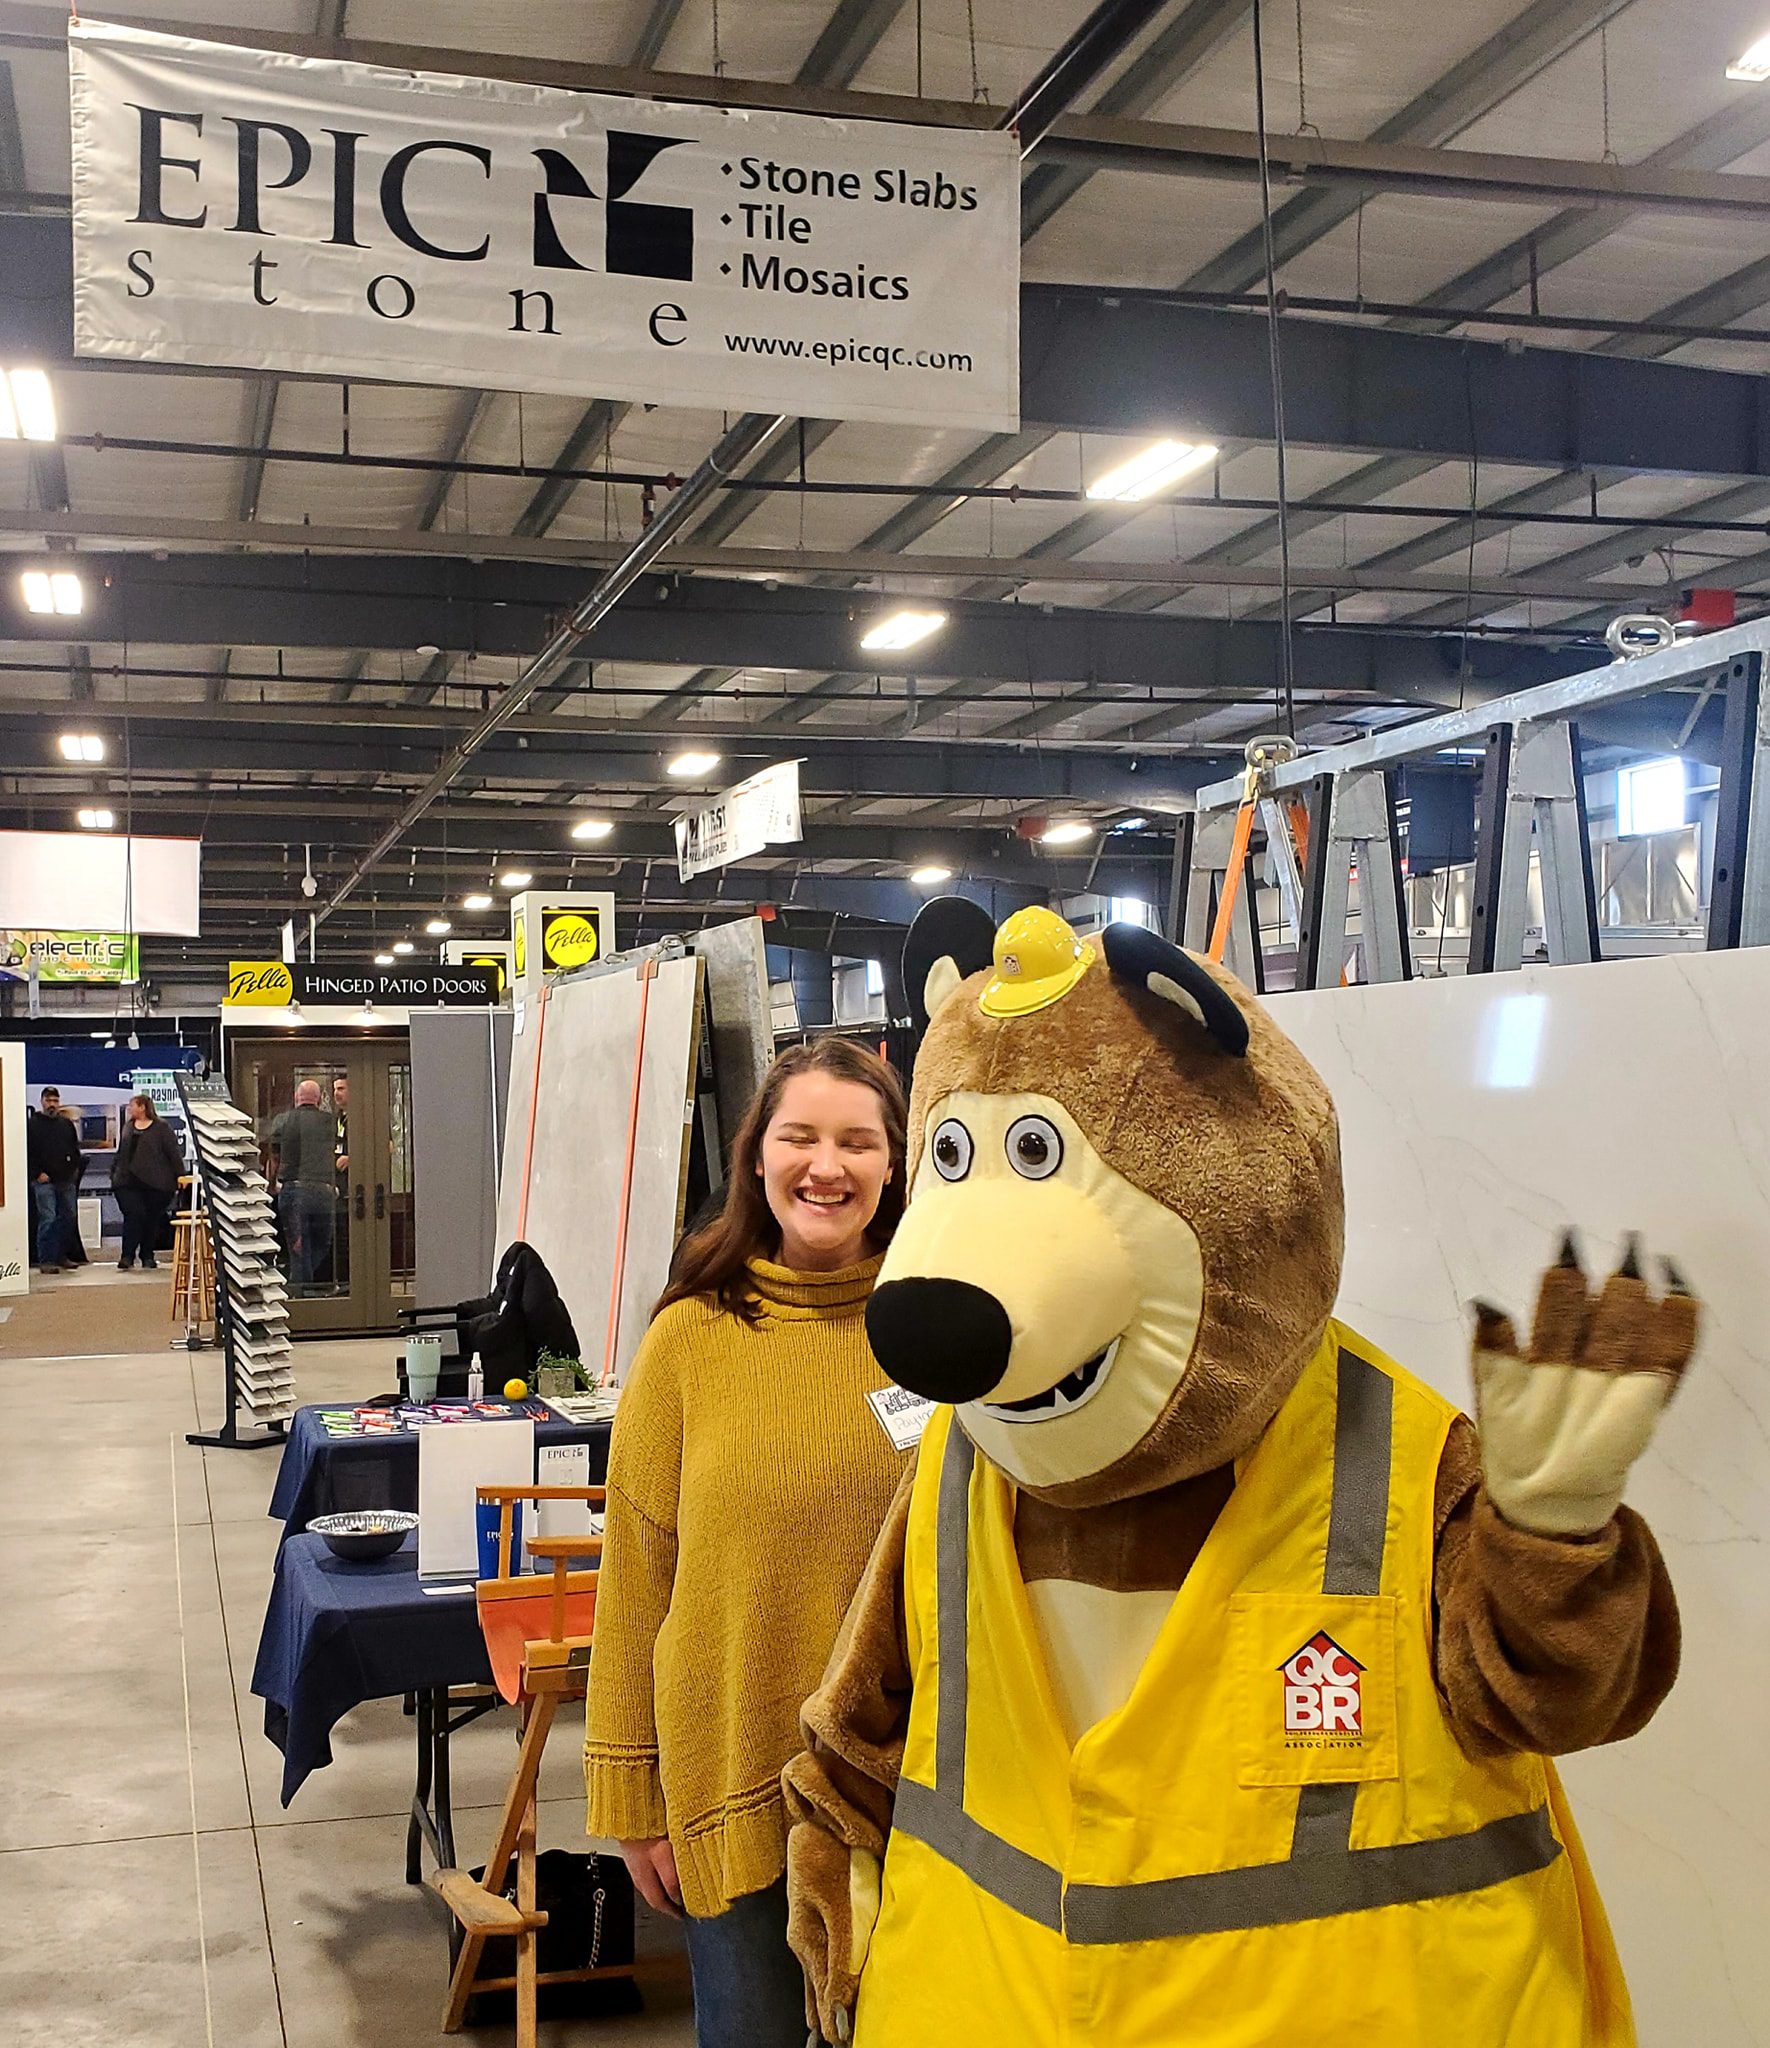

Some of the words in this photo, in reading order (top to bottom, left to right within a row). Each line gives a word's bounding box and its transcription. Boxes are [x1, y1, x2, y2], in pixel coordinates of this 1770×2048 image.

[124, 103, 491, 261] EPIC
[739, 157, 861, 199] Stone
[874, 169, 978, 211] Slabs
[739, 203, 811, 244] Tile
[742, 253, 909, 300] Mosaics
[127, 250, 688, 347] stone
[724, 334, 973, 372] www.epicqc.com
[548, 927, 593, 952] Pella
[230, 968, 289, 999] Pella
[305, 976, 374, 994] HINGED
[380, 976, 427, 994] PATIO
[433, 977, 487, 994] DOORS
[0, 1262, 21, 1280] ella
[1284, 1645, 1359, 1687] QC
[1285, 1685, 1361, 1730] BR
[1285, 1741, 1362, 1749] ASSOCIATION
